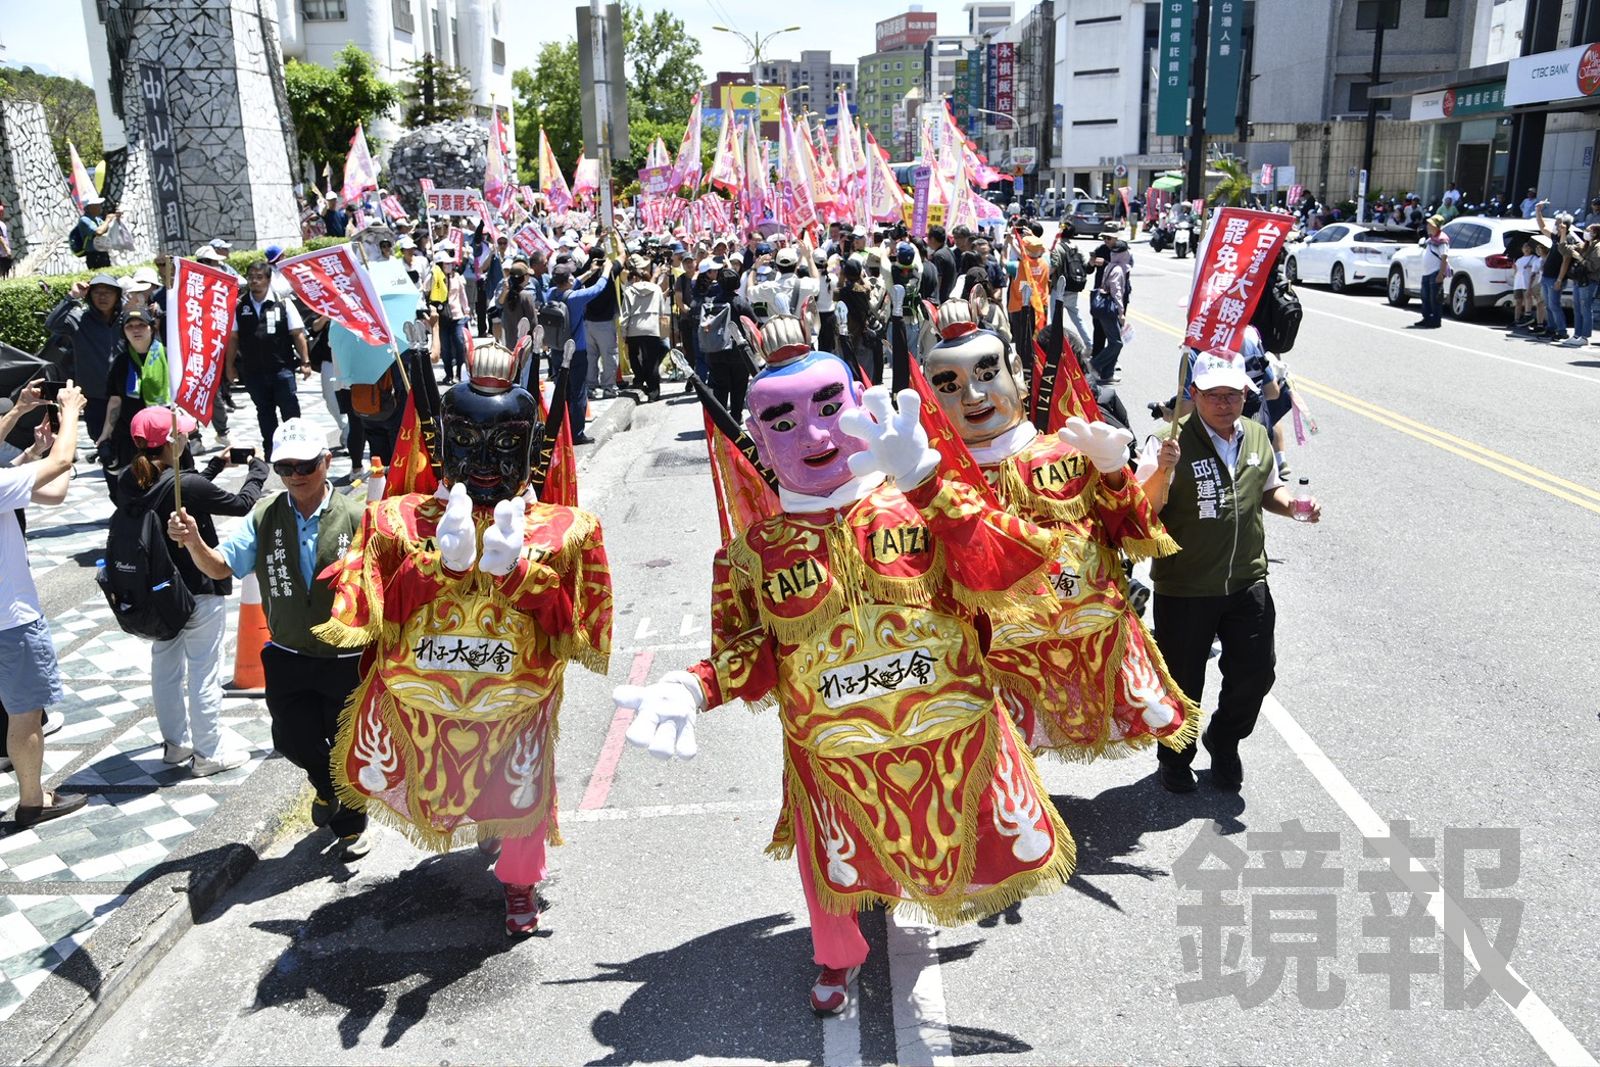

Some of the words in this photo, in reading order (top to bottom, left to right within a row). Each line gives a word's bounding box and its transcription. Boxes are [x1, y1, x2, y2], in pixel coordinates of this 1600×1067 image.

[1168, 3, 1182, 86] 中國信託銀行
[1219, 2, 1233, 56] 台灣人壽
[1531, 67, 1549, 79] CTBC
[1549, 63, 1570, 76] BANK
[143, 73, 183, 240] 中山公園
[1210, 223, 1280, 350] 台灣大勝利
[1032, 455, 1087, 487] TAIZI
[1191, 459, 1217, 519] 邱建富
[866, 525, 931, 558] TAIZI
[761, 557, 823, 606] TAIZI
